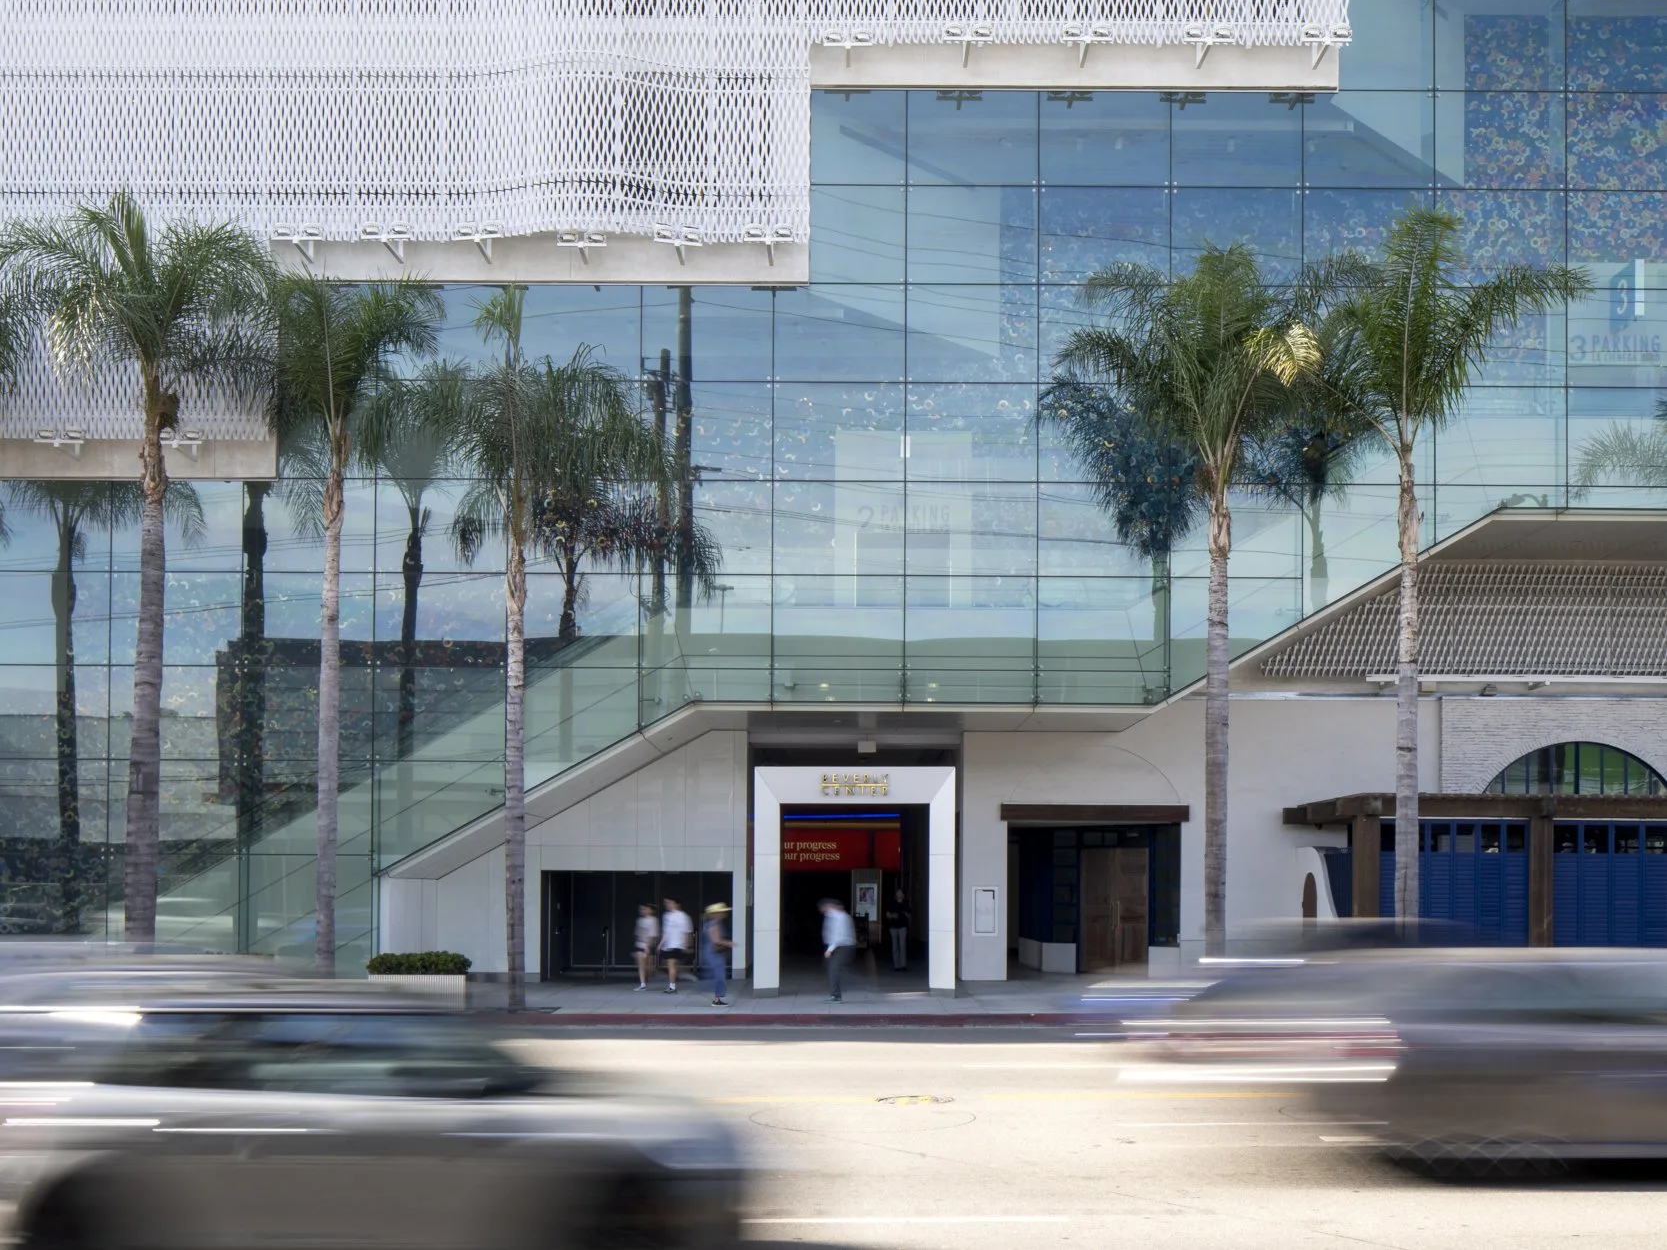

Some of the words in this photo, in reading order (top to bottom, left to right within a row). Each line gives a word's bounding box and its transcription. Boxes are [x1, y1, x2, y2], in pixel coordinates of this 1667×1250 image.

[1570, 335, 1586, 361] 3
[1592, 335, 1660, 352] PARKING
[823, 773, 889, 783] BEVERLY
[822, 786, 888, 796] CENTER
[796, 841, 838, 852] progress
[799, 853, 841, 863] progress
